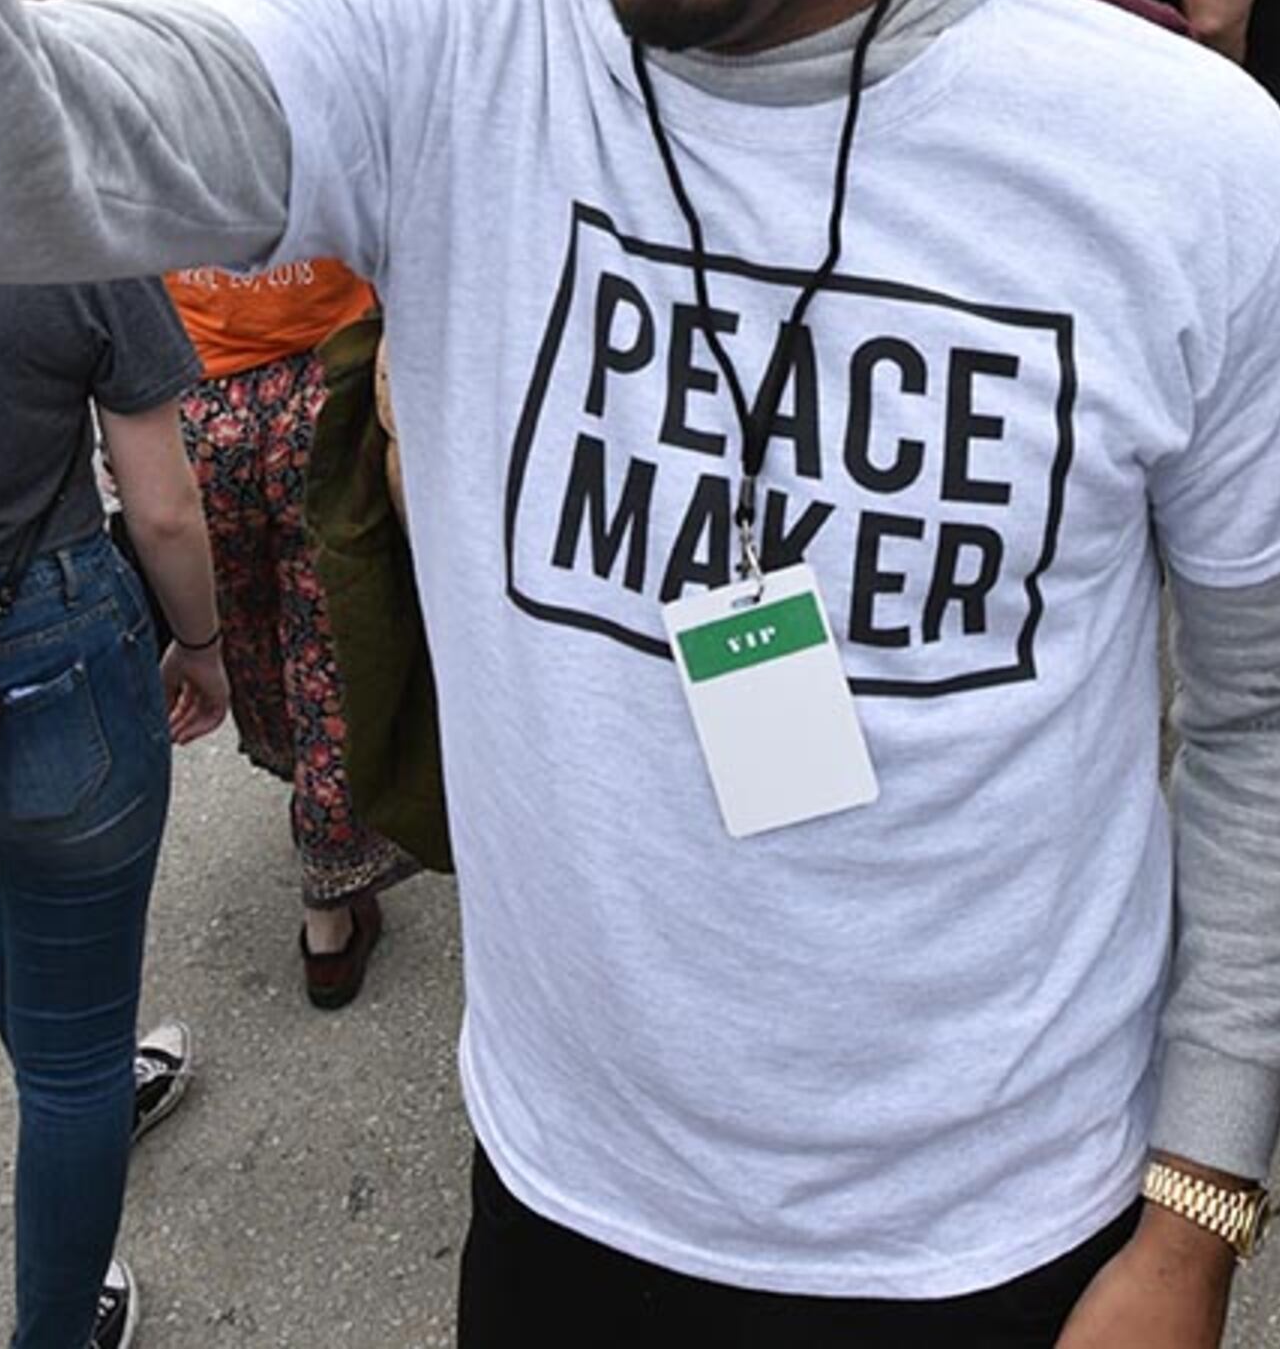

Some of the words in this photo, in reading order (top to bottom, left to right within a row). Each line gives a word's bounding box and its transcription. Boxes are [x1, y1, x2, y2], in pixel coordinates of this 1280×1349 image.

[584, 271, 1020, 505] PEACE
[551, 432, 1005, 648] MAKER
[726, 625, 777, 654] VIP
